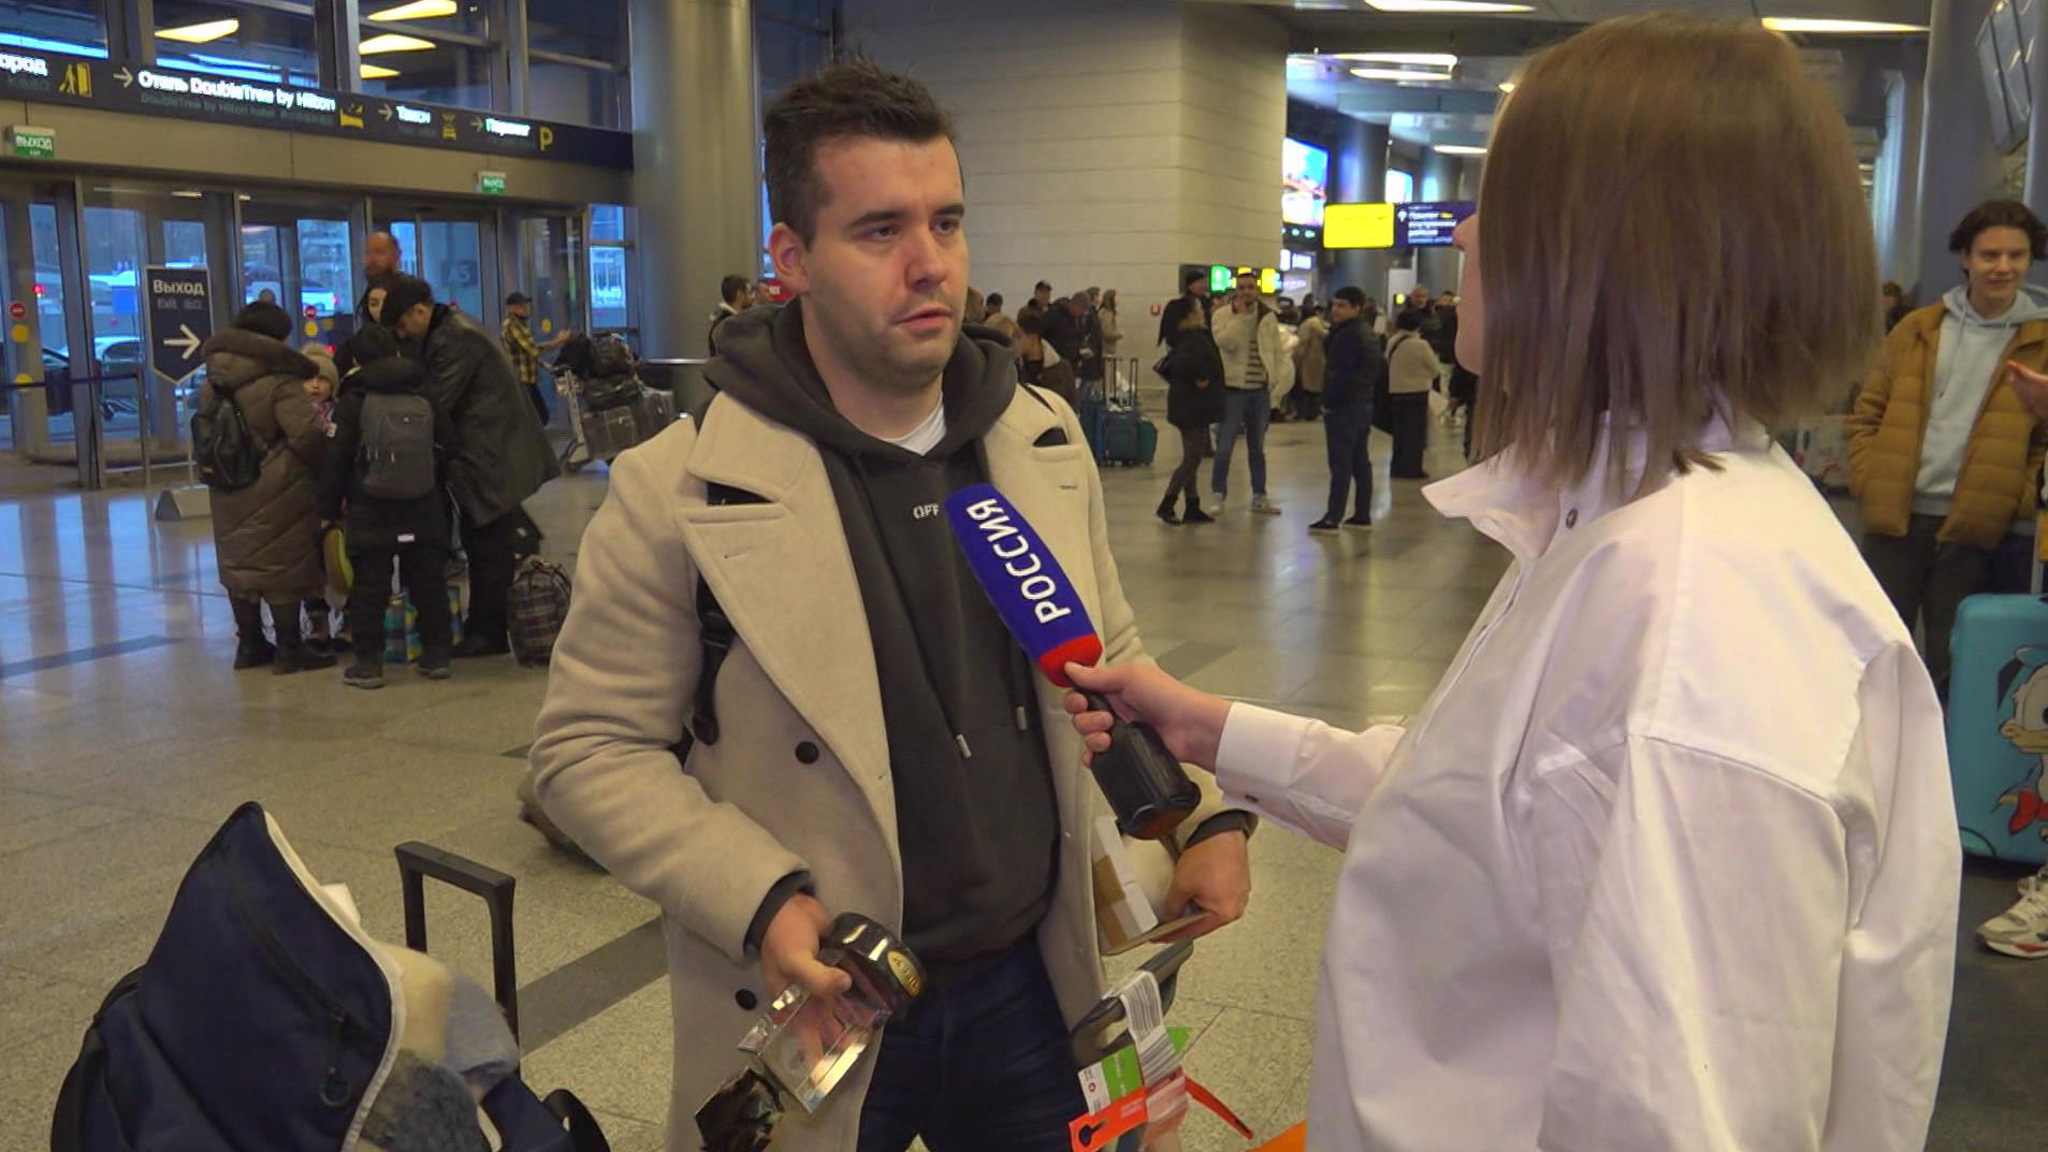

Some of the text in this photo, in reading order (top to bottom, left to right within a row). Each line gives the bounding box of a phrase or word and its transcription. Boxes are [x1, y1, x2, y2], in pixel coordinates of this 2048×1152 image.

[190, 77, 274, 103] DoubleTree
[277, 89, 294, 108] by
[296, 92, 336, 111] Hilton
[153, 279, 205, 296] Выход
[966, 498, 1072, 624] РОССИЯ
